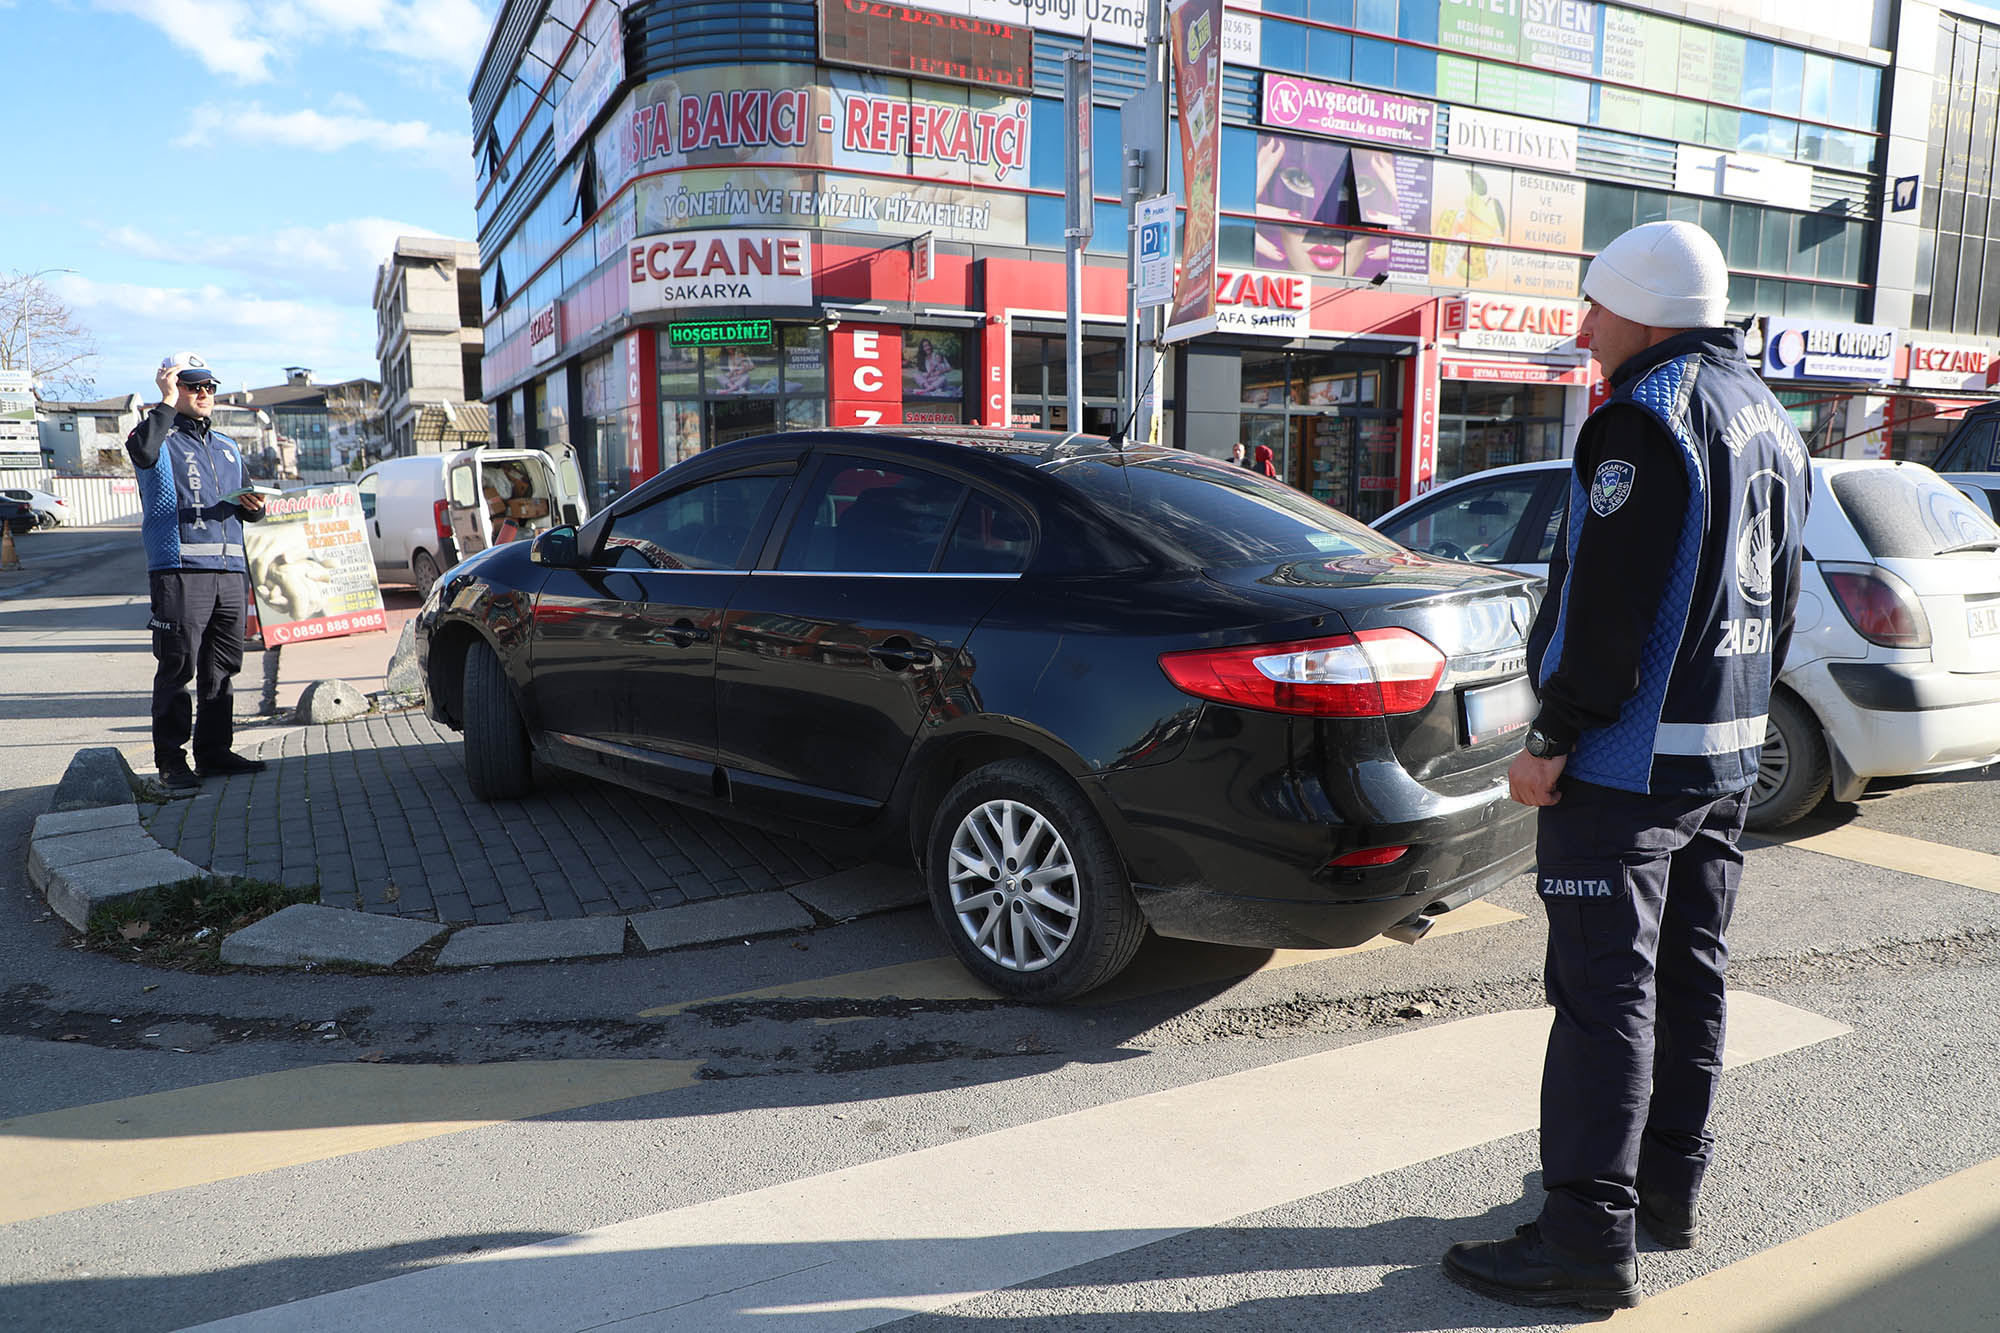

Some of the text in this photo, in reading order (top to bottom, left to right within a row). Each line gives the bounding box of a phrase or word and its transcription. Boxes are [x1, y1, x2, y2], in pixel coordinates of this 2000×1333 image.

[1086, 0, 1146, 29] Uzma
[1304, 88, 1379, 119] AYŞEGÜL
[1382, 102, 1430, 128] KURT
[679, 89, 811, 154] BAKICI
[843, 96, 1028, 180] REFEKATÇİ
[1320, 115, 1366, 136] GÜZELLİK
[1376, 125, 1413, 142] ESTETİK
[1457, 118, 1571, 161] DİYETİSYEN
[1519, 175, 1577, 196] BESLENME
[664, 182, 992, 231] YÖNETİM VE TEMİZLİK HİZMETLERİ
[630, 238, 804, 284] ECZANE
[663, 282, 752, 302] SAKARYA
[1216, 271, 1304, 311] ZANE
[1217, 311, 1296, 329] AFA ŞAHİN
[1448, 304, 1462, 326] E
[1469, 300, 1574, 337] ECZANE
[672, 323, 769, 345] HOŞGELDİNİZ
[1807, 330, 1838, 354] EREN
[1915, 346, 1990, 374] ECZANE
[852, 329, 884, 426] ECZ
[628, 336, 641, 474] ECZA
[905, 411, 956, 424] SAKARYA
[1419, 387, 1433, 493] ECZAN
[1597, 463, 1629, 477] SAKARYA
[183, 450, 208, 531] ZABITA
[292, 613, 383, 638] 0850 888 9085
[1543, 878, 1613, 897] ZABITA
